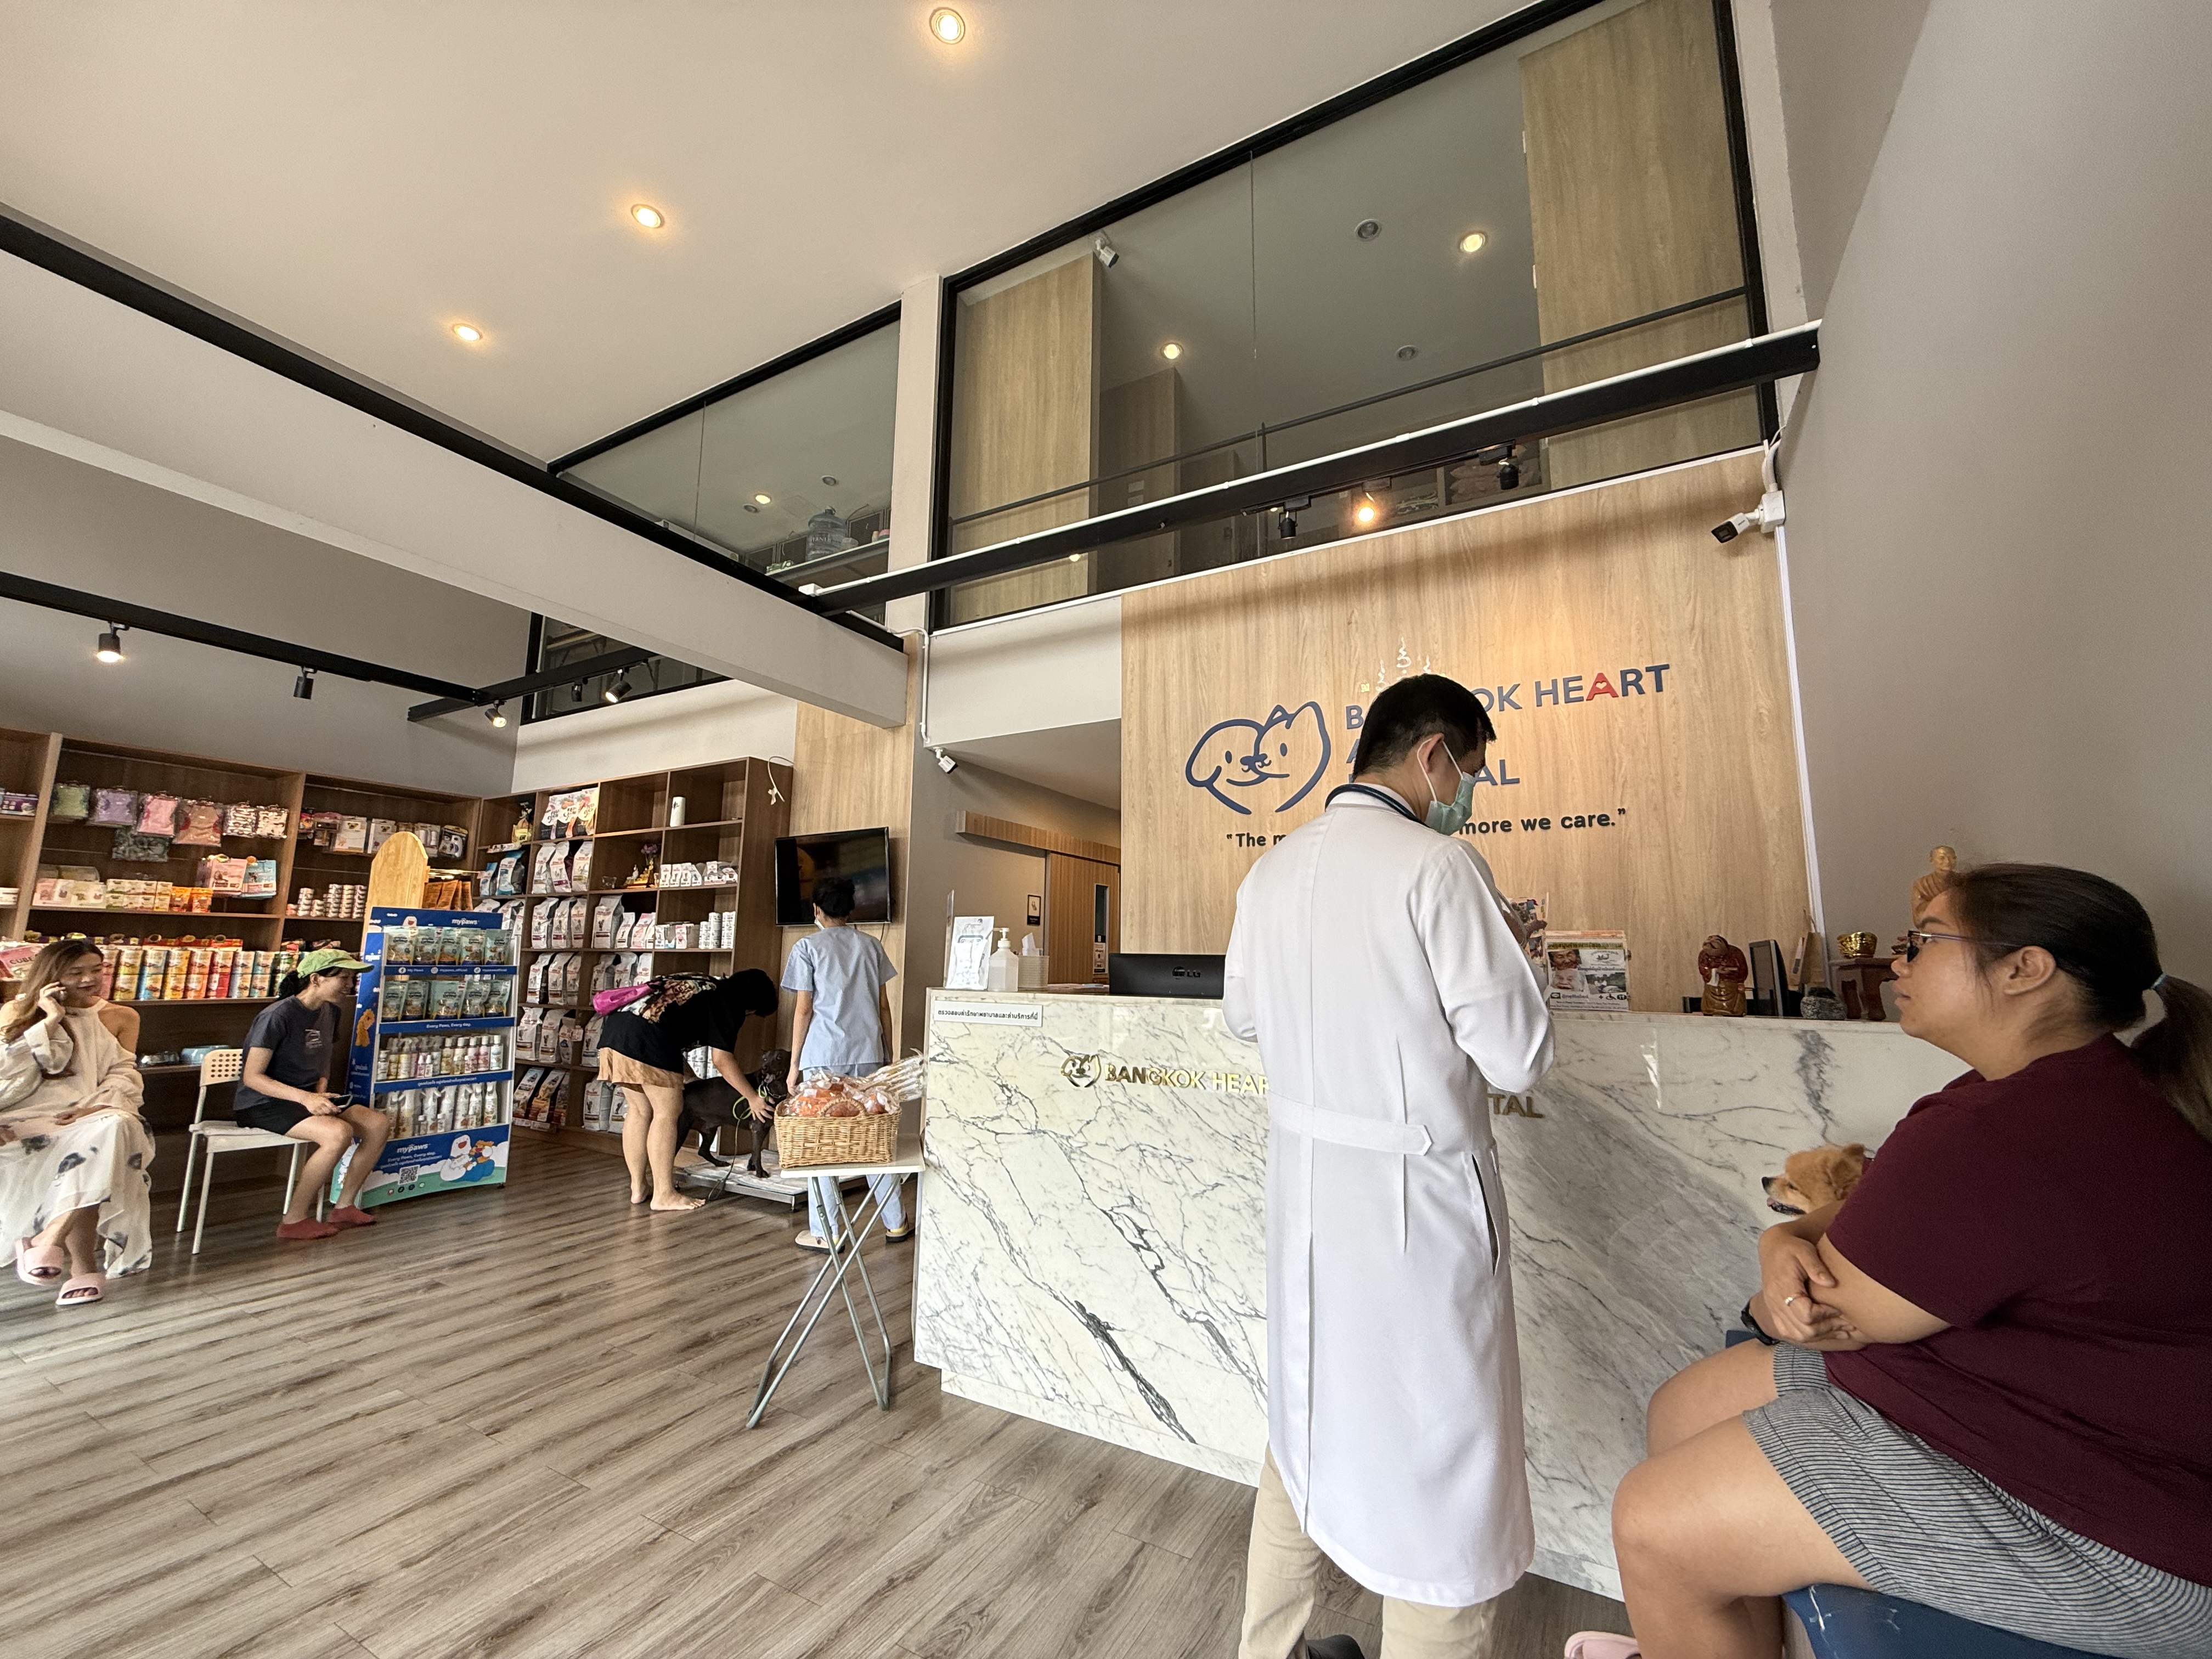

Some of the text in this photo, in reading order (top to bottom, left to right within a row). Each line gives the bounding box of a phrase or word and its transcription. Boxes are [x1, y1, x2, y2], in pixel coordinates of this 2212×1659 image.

[1535, 664, 1670, 707] HEART
[1459, 820, 1512, 835] more
[1521, 817, 1551, 831] we
[1187, 969, 1201, 978] LG
[1104, 1064, 1269, 1095] BANGKOK HEAR
[397, 1143, 428, 1154] mypaws
